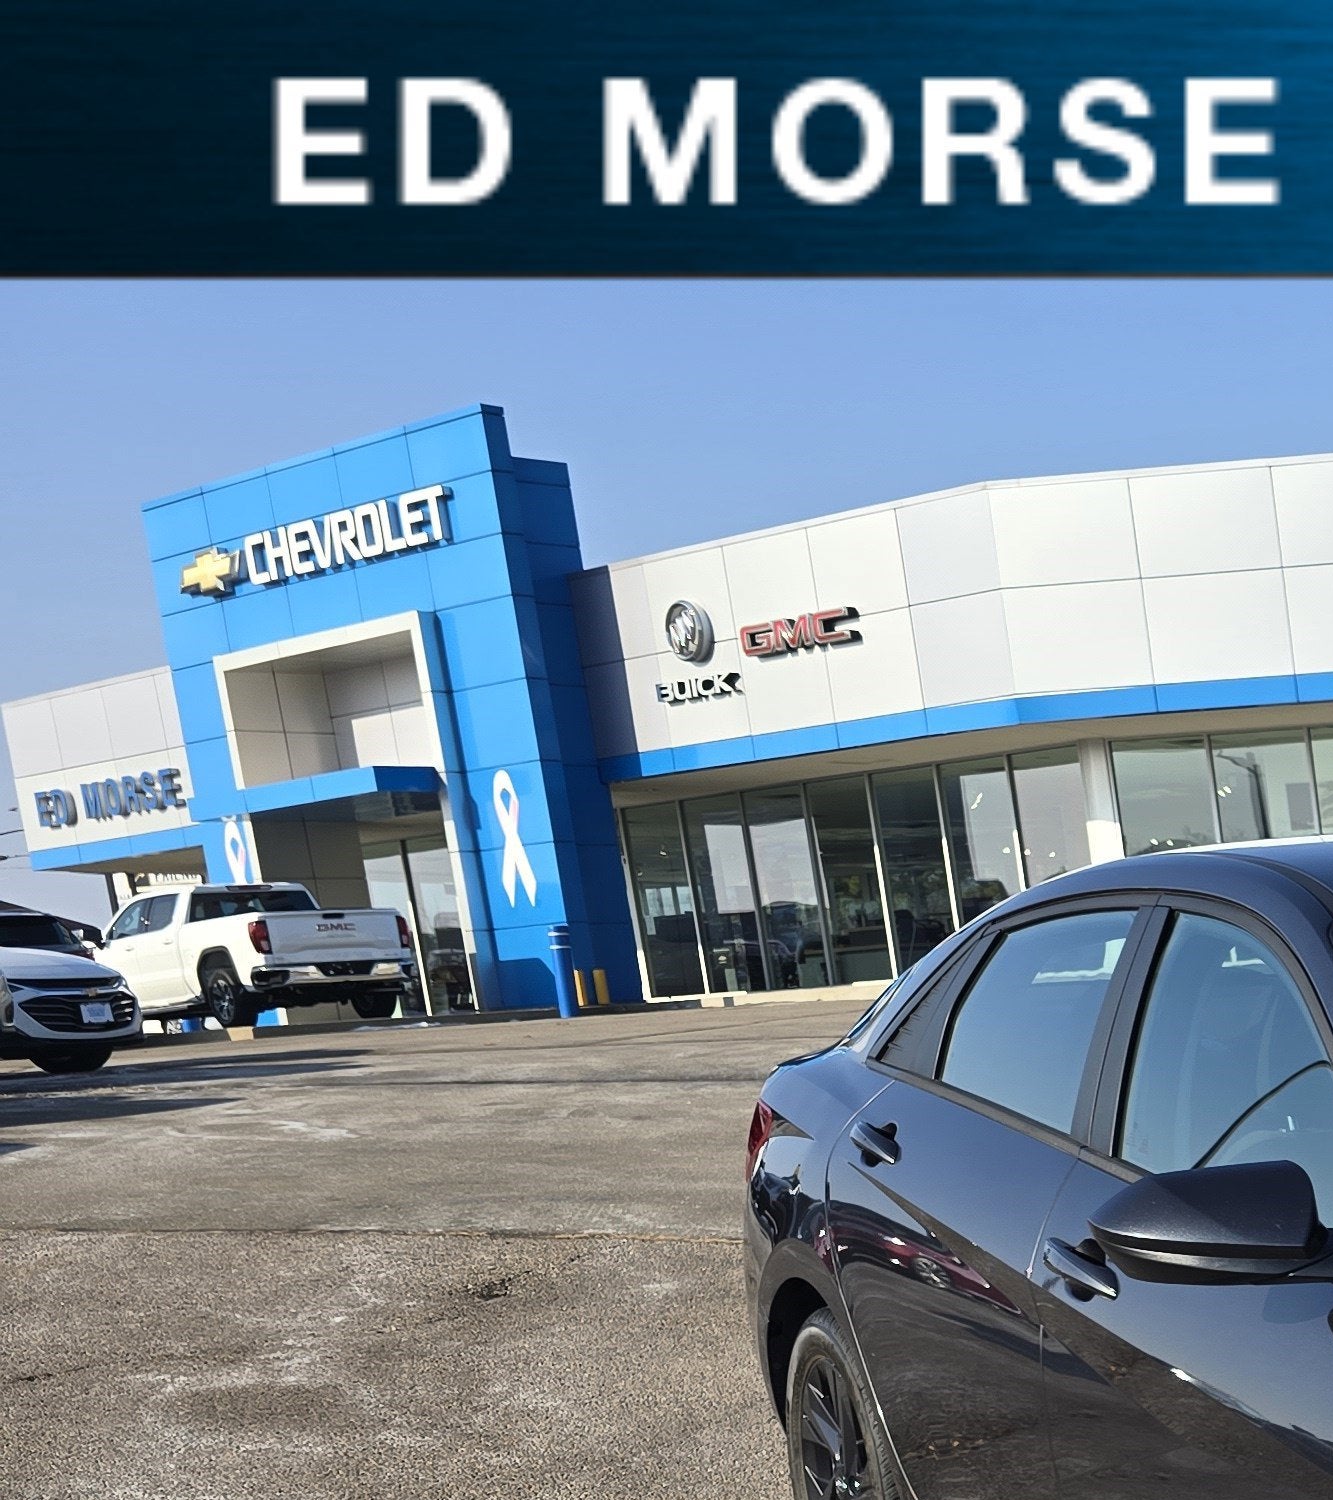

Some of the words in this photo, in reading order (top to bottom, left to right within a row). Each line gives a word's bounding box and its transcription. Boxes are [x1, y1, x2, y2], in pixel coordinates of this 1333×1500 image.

[244, 484, 450, 586] CHEVROLET
[739, 606, 857, 658] GMC
[656, 672, 742, 704] BUICK
[34, 789, 75, 827] ED
[80, 768, 186, 819] MORSE
[316, 922, 356, 932] GMC
